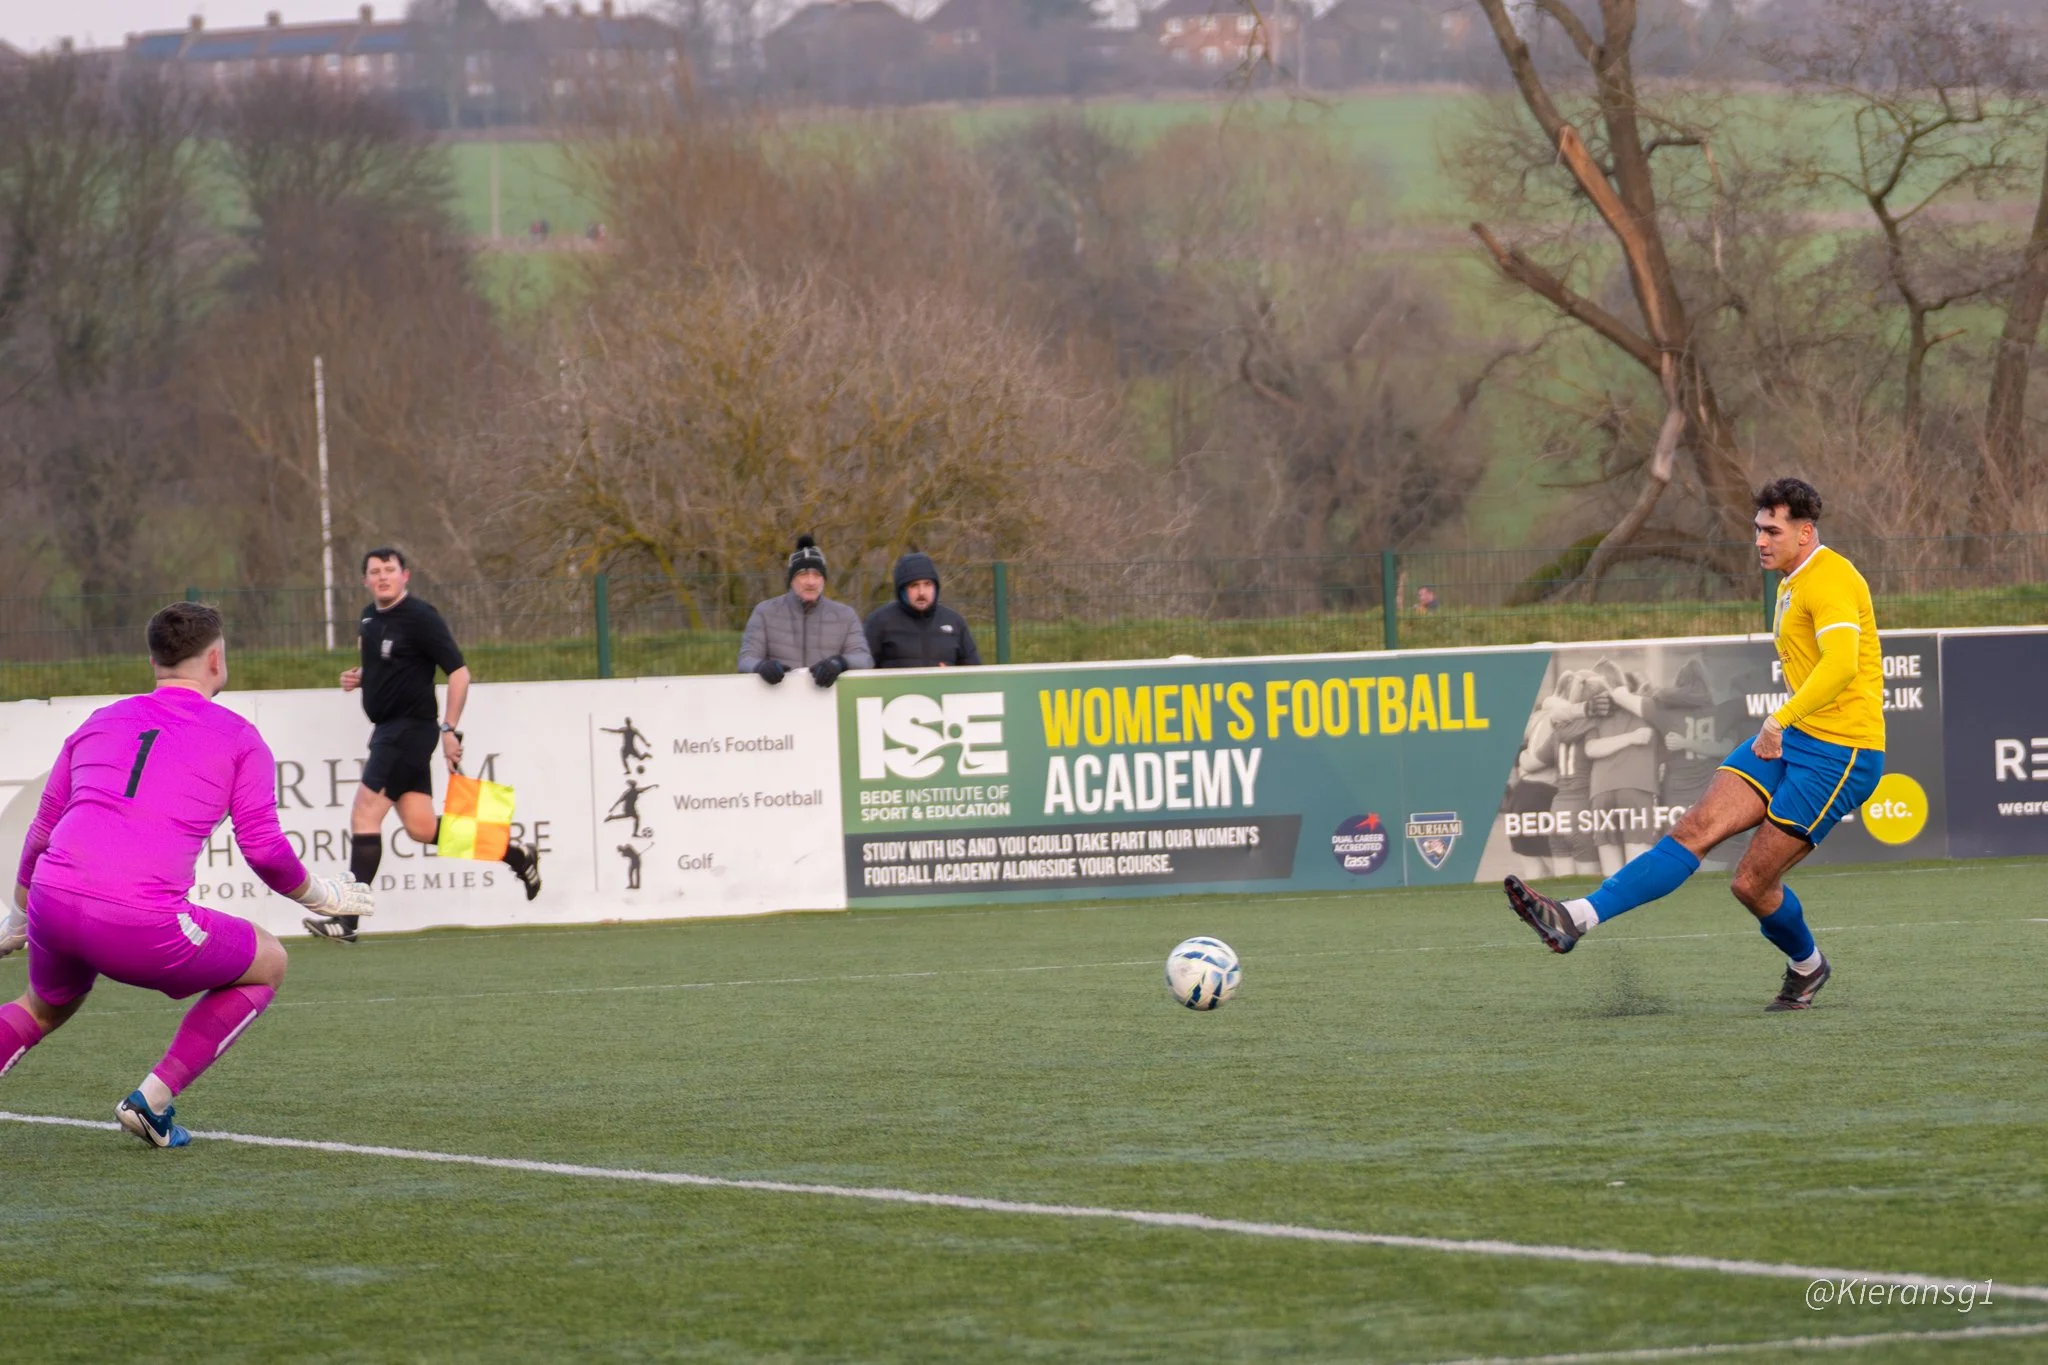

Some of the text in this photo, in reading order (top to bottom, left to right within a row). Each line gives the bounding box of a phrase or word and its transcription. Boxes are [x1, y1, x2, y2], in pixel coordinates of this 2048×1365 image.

[1882, 654, 1922, 678] ORE
[1039, 671, 1489, 747] WOMEN'S FOOTBALL
[673, 734, 795, 754] Men's Football
[856, 691, 1009, 780] ISE
[123, 729, 160, 798] 1
[1043, 747, 1262, 814] ACADEMY
[674, 789, 823, 811] Women's Football
[859, 785, 1010, 805] BEDE INSTITUTE OF
[860, 802, 1011, 822] SPORT & EDUCATION
[1504, 804, 1686, 836] BEDE SIXTH FO
[1868, 798, 1913, 819] etc.
[1331, 833, 1384, 844] DUAL CAREER
[1409, 824, 1459, 836] DURHAM
[863, 825, 1260, 862] STUDY WITH US AND YOU COULD TAKE PART IN OUR WOMEN'S
[677, 853, 713, 870] Golf
[864, 853, 1174, 887] FOOTBALL ACADEMY ALONGSIDE YOUR COURSE.
